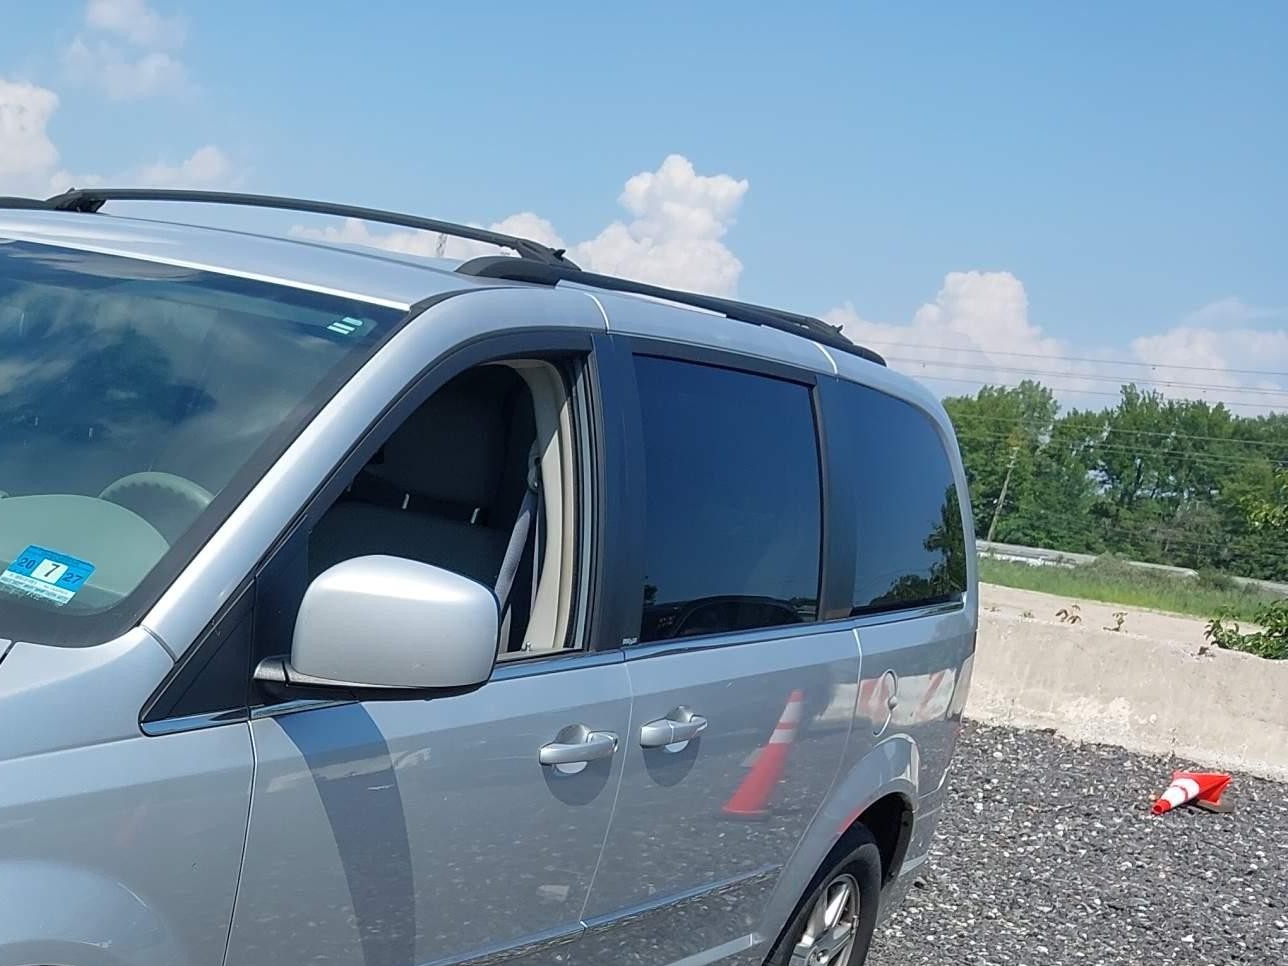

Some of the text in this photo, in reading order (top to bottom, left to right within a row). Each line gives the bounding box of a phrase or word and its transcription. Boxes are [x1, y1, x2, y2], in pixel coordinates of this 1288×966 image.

[18, 557, 36, 570] 20
[43, 563, 61, 578] 7
[62, 572, 83, 585] 27
